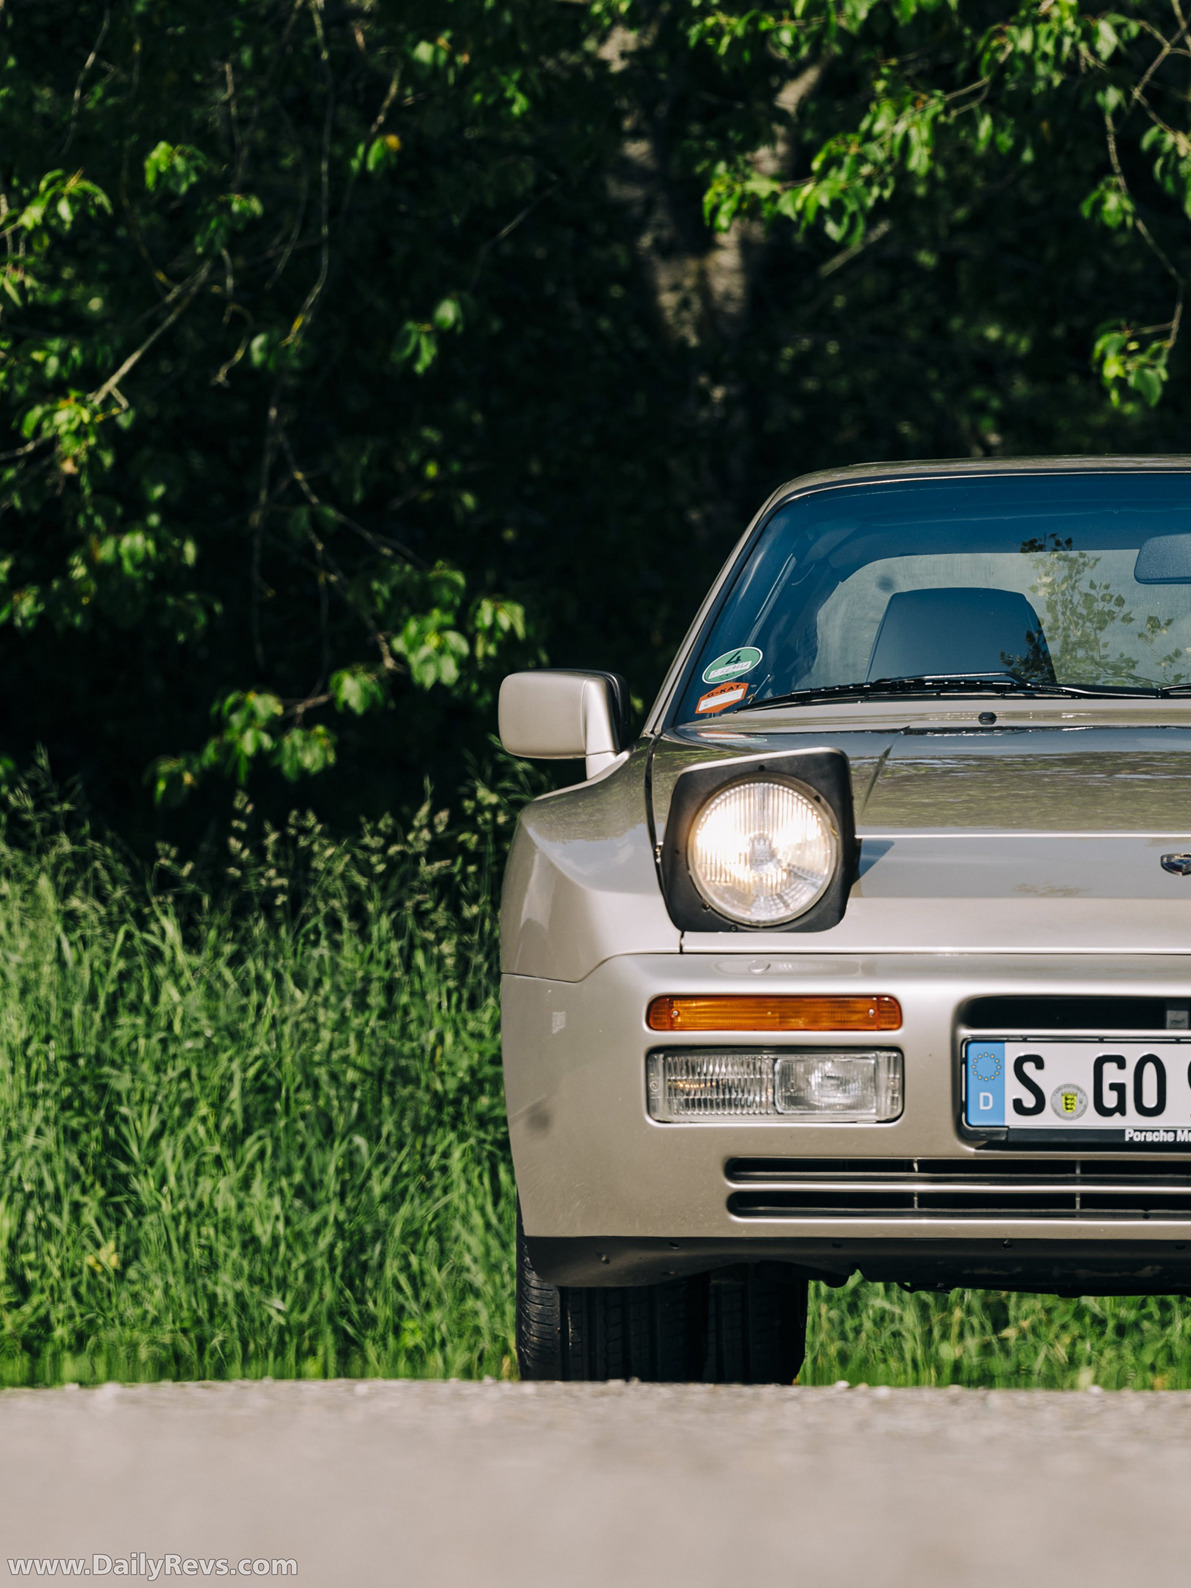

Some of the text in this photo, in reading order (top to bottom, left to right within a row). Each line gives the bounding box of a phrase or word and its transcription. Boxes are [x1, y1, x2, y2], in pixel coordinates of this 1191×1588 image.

[725, 650, 742, 664] 4
[1012, 1054, 1046, 1117] S
[1093, 1054, 1167, 1117] GO
[979, 1092, 993, 1110] D
[1125, 1128, 1175, 1142] Porsche
